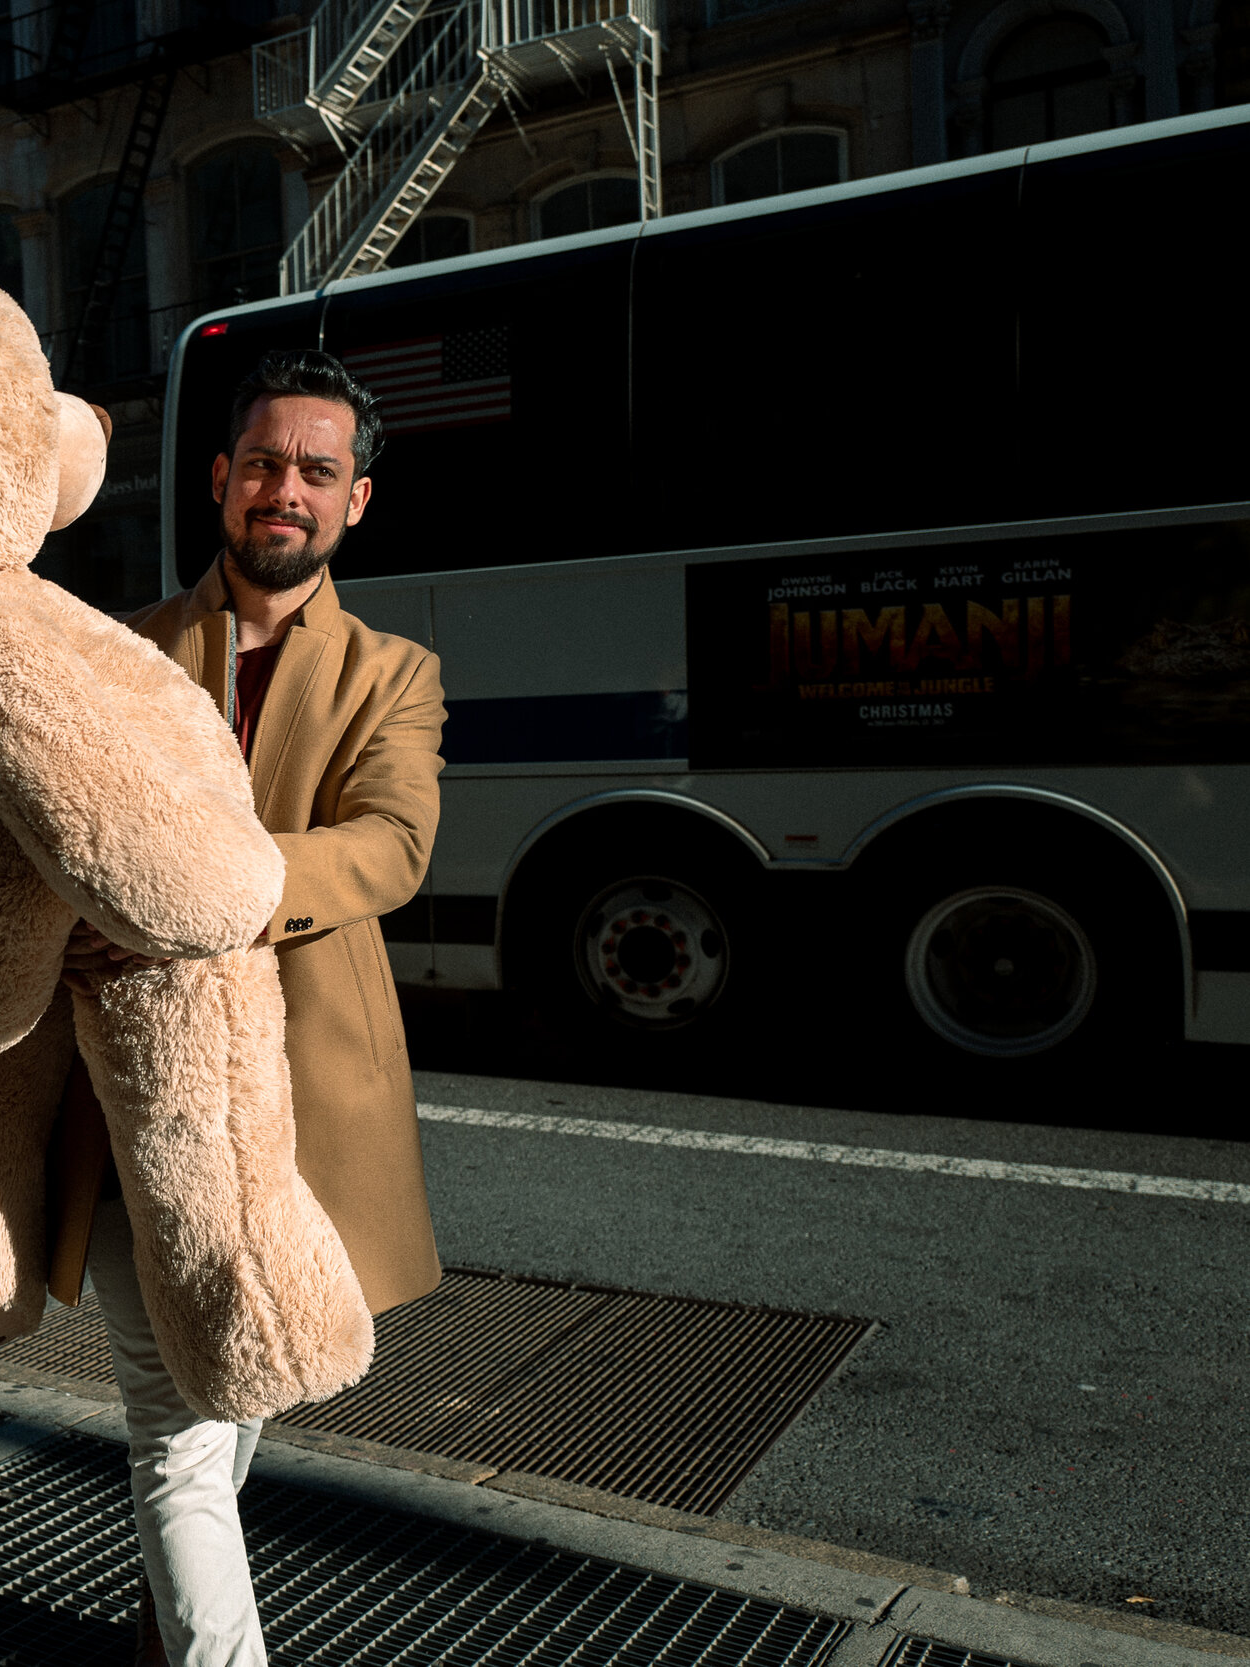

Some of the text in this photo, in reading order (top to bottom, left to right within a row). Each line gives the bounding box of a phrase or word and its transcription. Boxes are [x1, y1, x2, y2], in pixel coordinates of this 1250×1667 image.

[938, 564, 980, 576] KEVIN
[1012, 558, 1061, 571] KAREN
[781, 574, 832, 587] DWAYNE
[874, 569, 905, 581] JACK
[933, 573, 986, 589] HART
[1000, 567, 1073, 584] GILLAN
[767, 583, 847, 602] JOHNSON
[860, 578, 919, 594] BLACK
[751, 594, 1072, 693] JUMANJI
[797, 680, 895, 701] WELCOME
[914, 676, 996, 696] JUNGLE
[858, 702, 954, 720] CHRISTMAS
